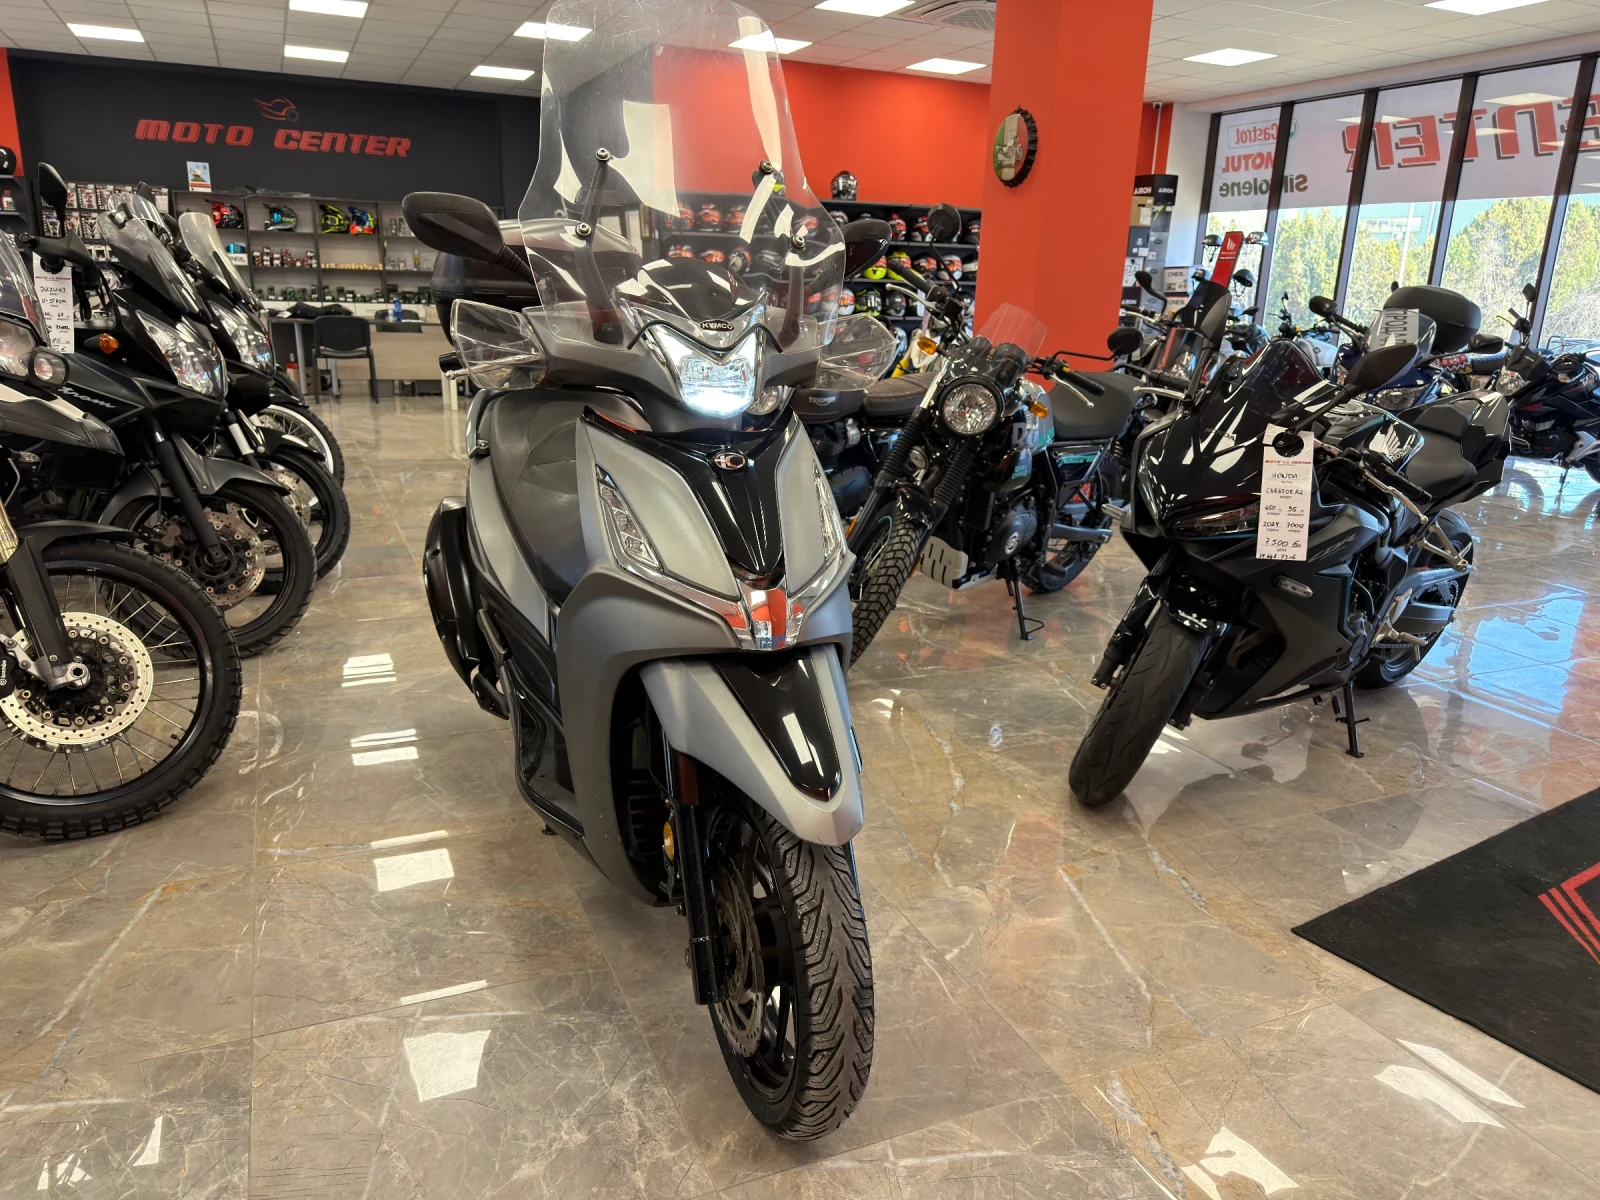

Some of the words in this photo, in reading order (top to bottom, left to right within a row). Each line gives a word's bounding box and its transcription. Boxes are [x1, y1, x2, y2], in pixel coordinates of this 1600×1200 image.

[134, 119, 254, 147] MOTO
[273, 129, 412, 158] CENTER
[702, 322, 734, 330] KYMCO
